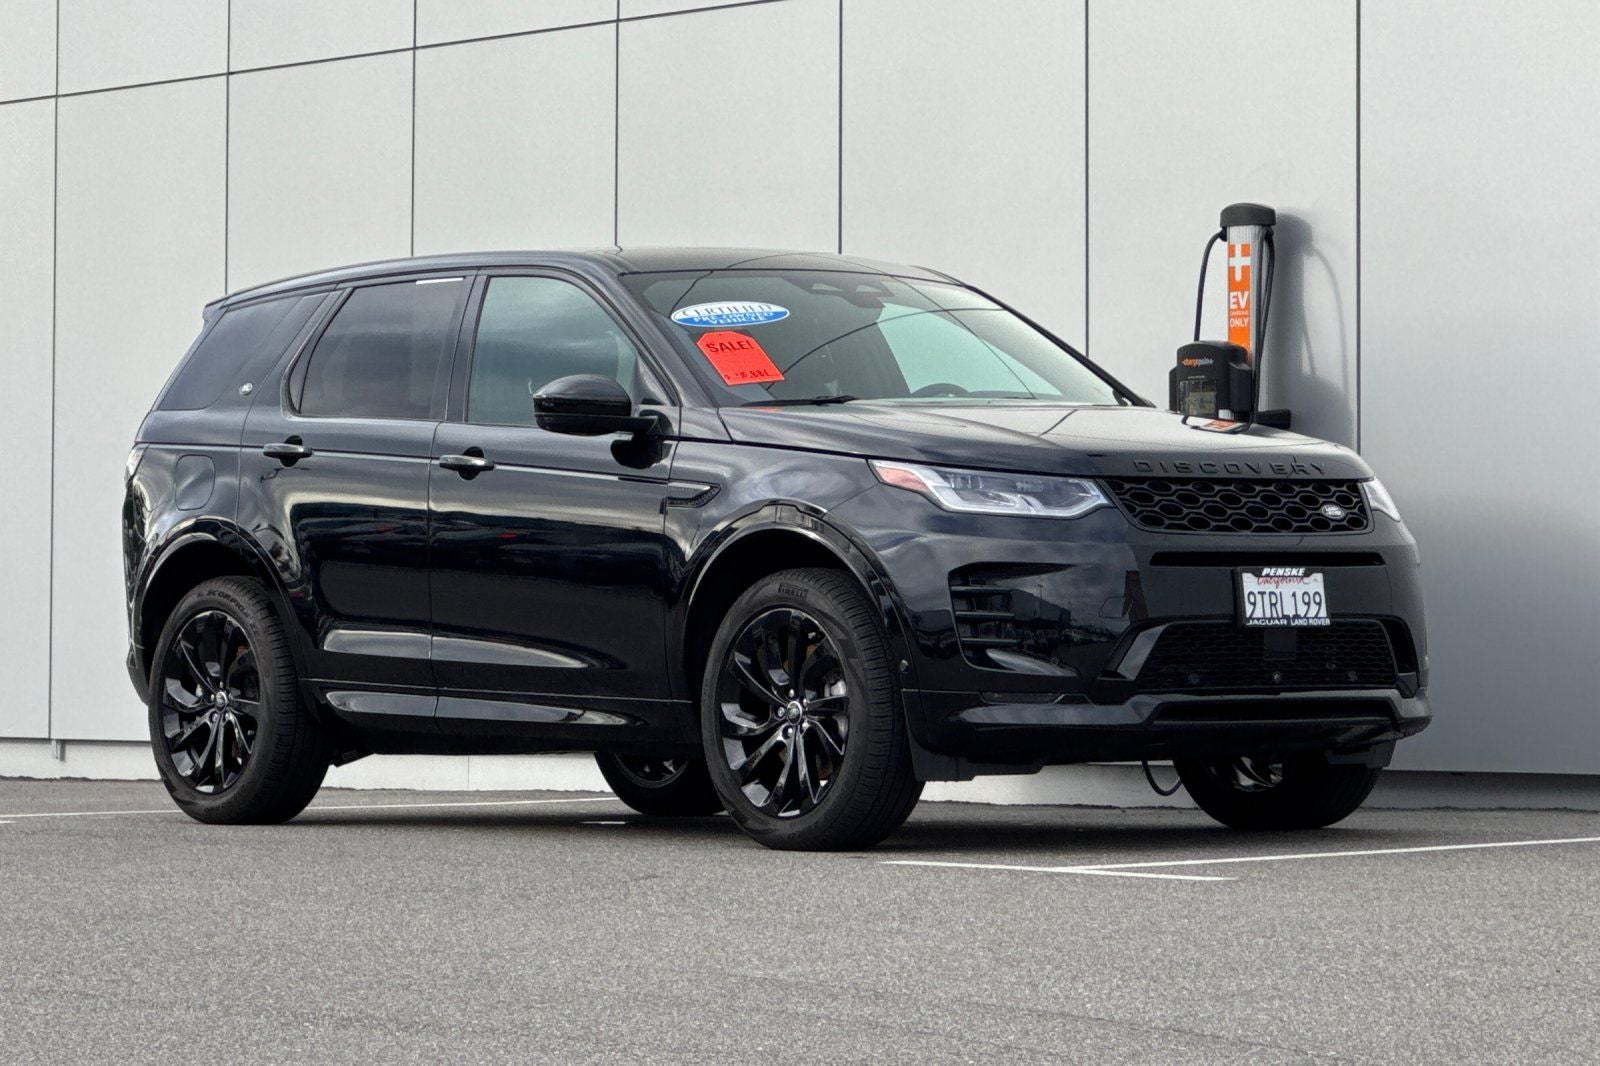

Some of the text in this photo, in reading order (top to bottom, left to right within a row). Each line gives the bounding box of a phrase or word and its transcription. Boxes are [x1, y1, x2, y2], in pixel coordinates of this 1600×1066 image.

[1229, 291, 1249, 310] EV
[682, 304, 774, 317] CERTIFIED
[1229, 317, 1249, 328] ONLY
[705, 340, 755, 354] SALE!
[1132, 459, 1326, 476] DISCOVERY
[1261, 567, 1306, 577] PENSKE
[1245, 618, 1288, 626] JAGUAR
[1290, 618, 1308, 626] LAND
